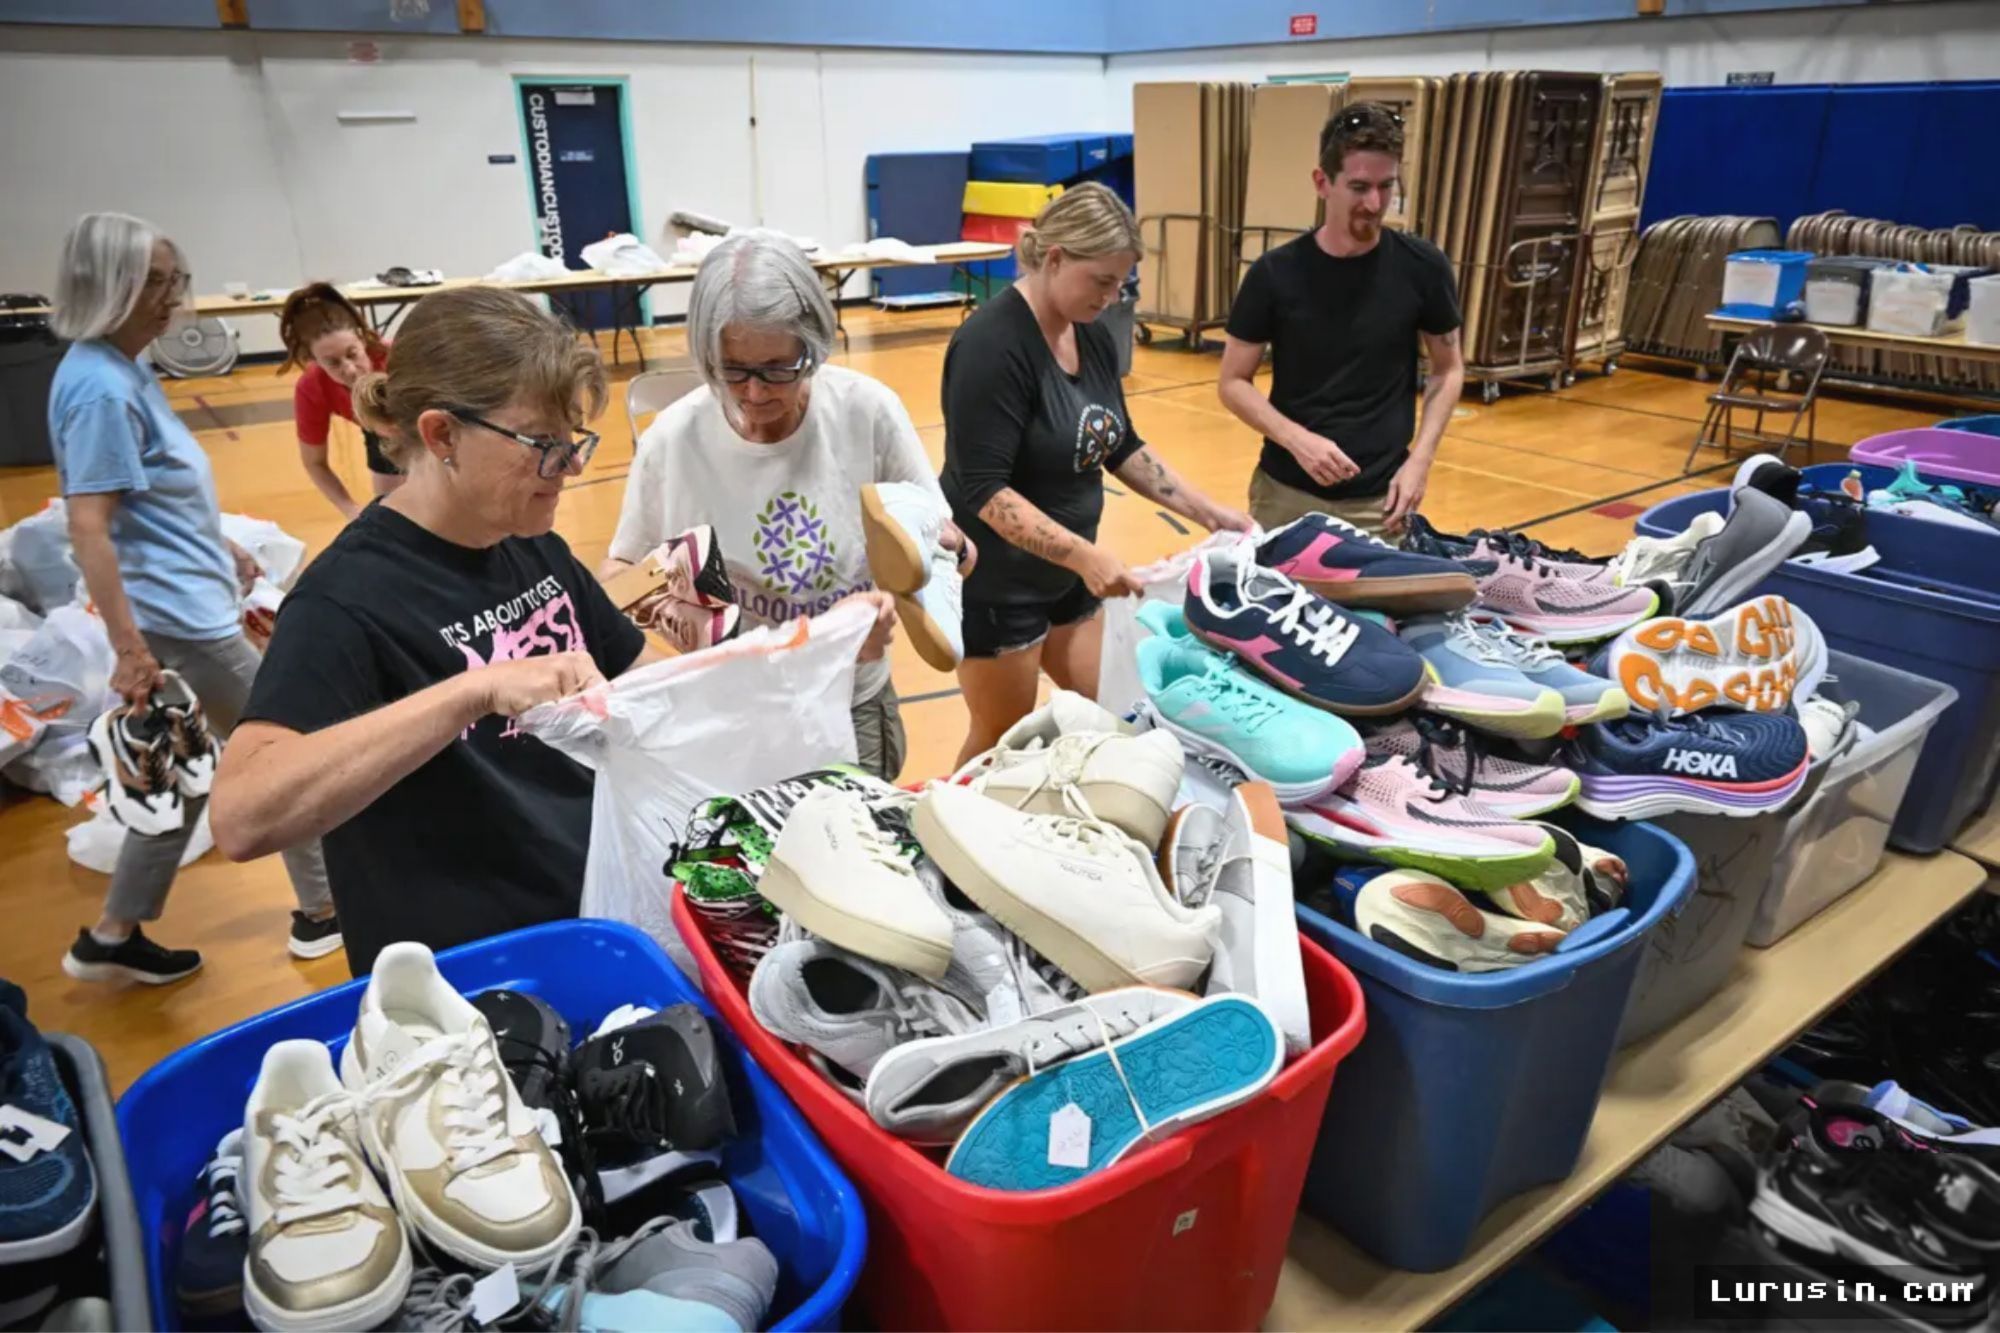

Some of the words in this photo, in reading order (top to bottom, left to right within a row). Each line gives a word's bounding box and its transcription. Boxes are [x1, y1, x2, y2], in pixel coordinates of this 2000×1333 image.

[472, 598, 525, 637] ABOUT
[536, 575, 564, 601] GET
[1662, 747, 1738, 779] HOKA
